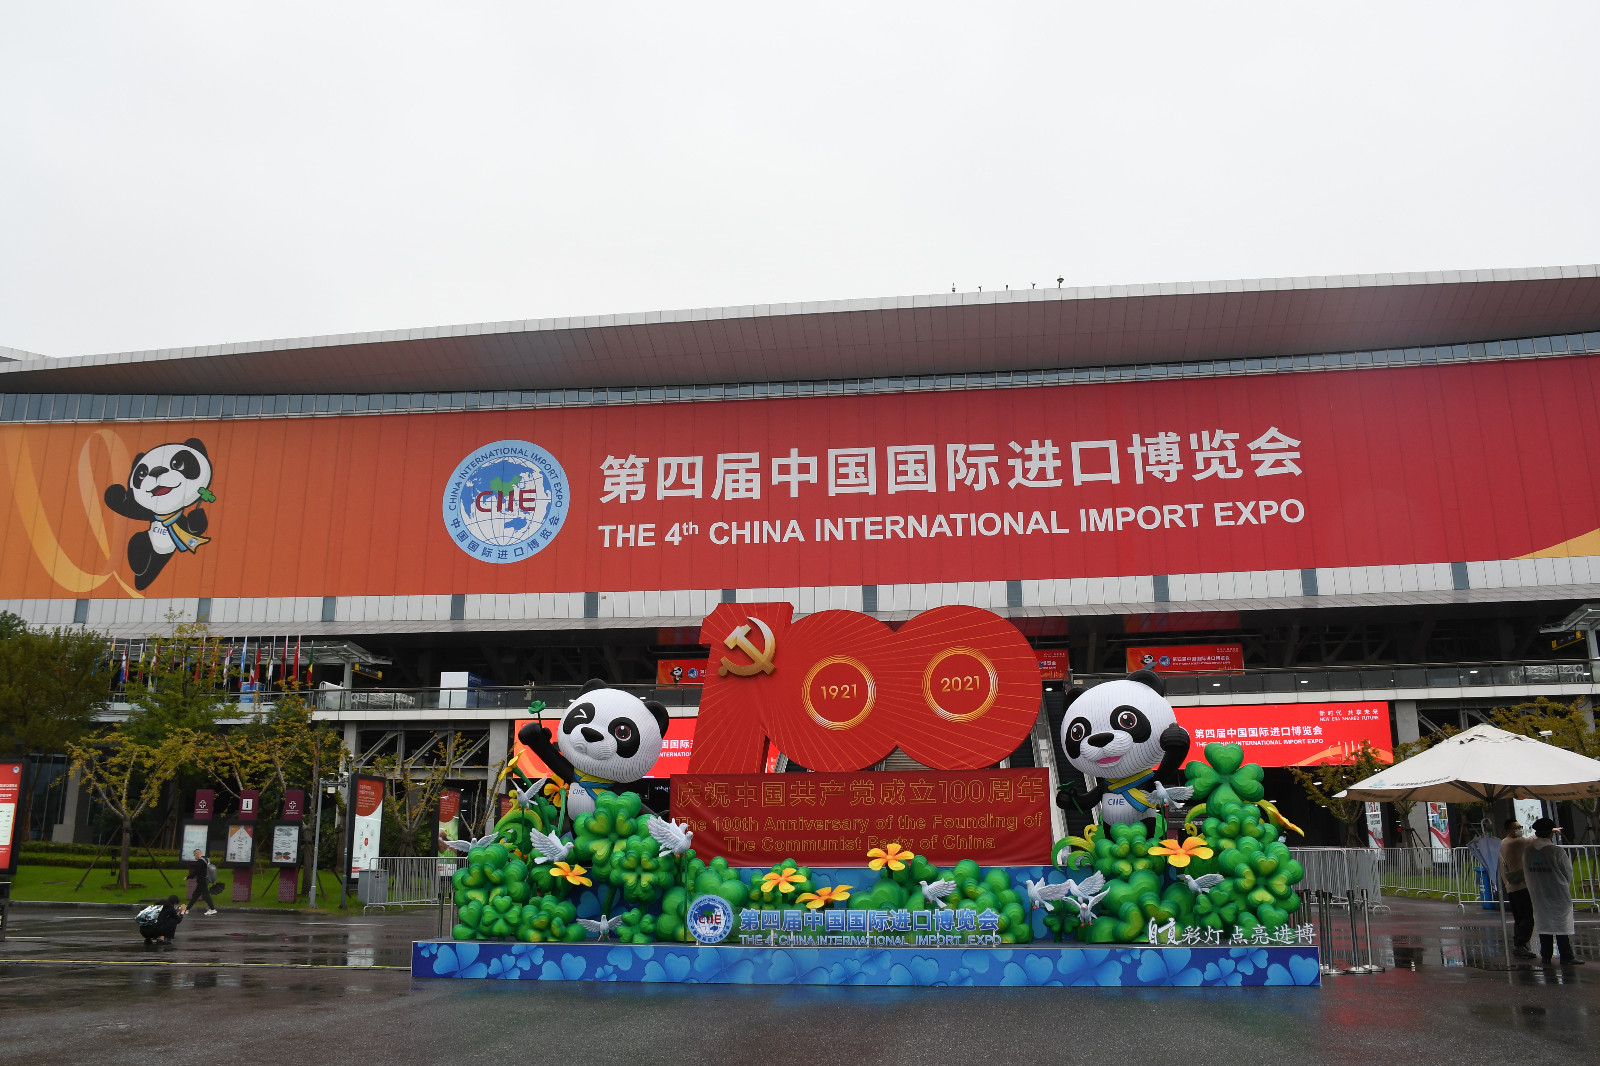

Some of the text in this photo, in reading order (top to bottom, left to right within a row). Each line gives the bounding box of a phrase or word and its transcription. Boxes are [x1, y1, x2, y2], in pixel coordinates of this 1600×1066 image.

[599, 426, 1302, 504] 第四届中国国际进口博览会
[449, 447, 563, 511] CHINA INTERNATIONAL IMPORT EXPO
[475, 489, 536, 513] CIIE
[153, 526, 167, 536] CIIE
[598, 498, 1305, 548] THE 4th CHINA INTERNATIONAL IMPORT EXPO
[450, 515, 560, 560] 中国国际进口博览会
[820, 683, 858, 700] 1921
[940, 675, 980, 692] 2021
[1194, 725, 1323, 739] 第四届中国国际进口博览会
[675, 775, 1045, 808] 庆祝中国共产党成立100周年
[1107, 798, 1125, 806] CIIE
[675, 811, 1043, 834] The 100th Anniversary of the Founding of
[723, 836, 756, 852] The
[761, 836, 862, 852] Communist
[919, 834, 938, 850] of
[942, 834, 996, 850] China
[698, 914, 722, 924] CIIE
[739, 908, 1000, 932] 第四届中国国际进口博览会
[739, 934, 763, 946] THE
[778, 934, 815, 946] CHINA
[816, 934, 909, 946] INTERNATIONAL
[915, 934, 962, 946] IMPORT
[967, 934, 1002, 946] EXPO
